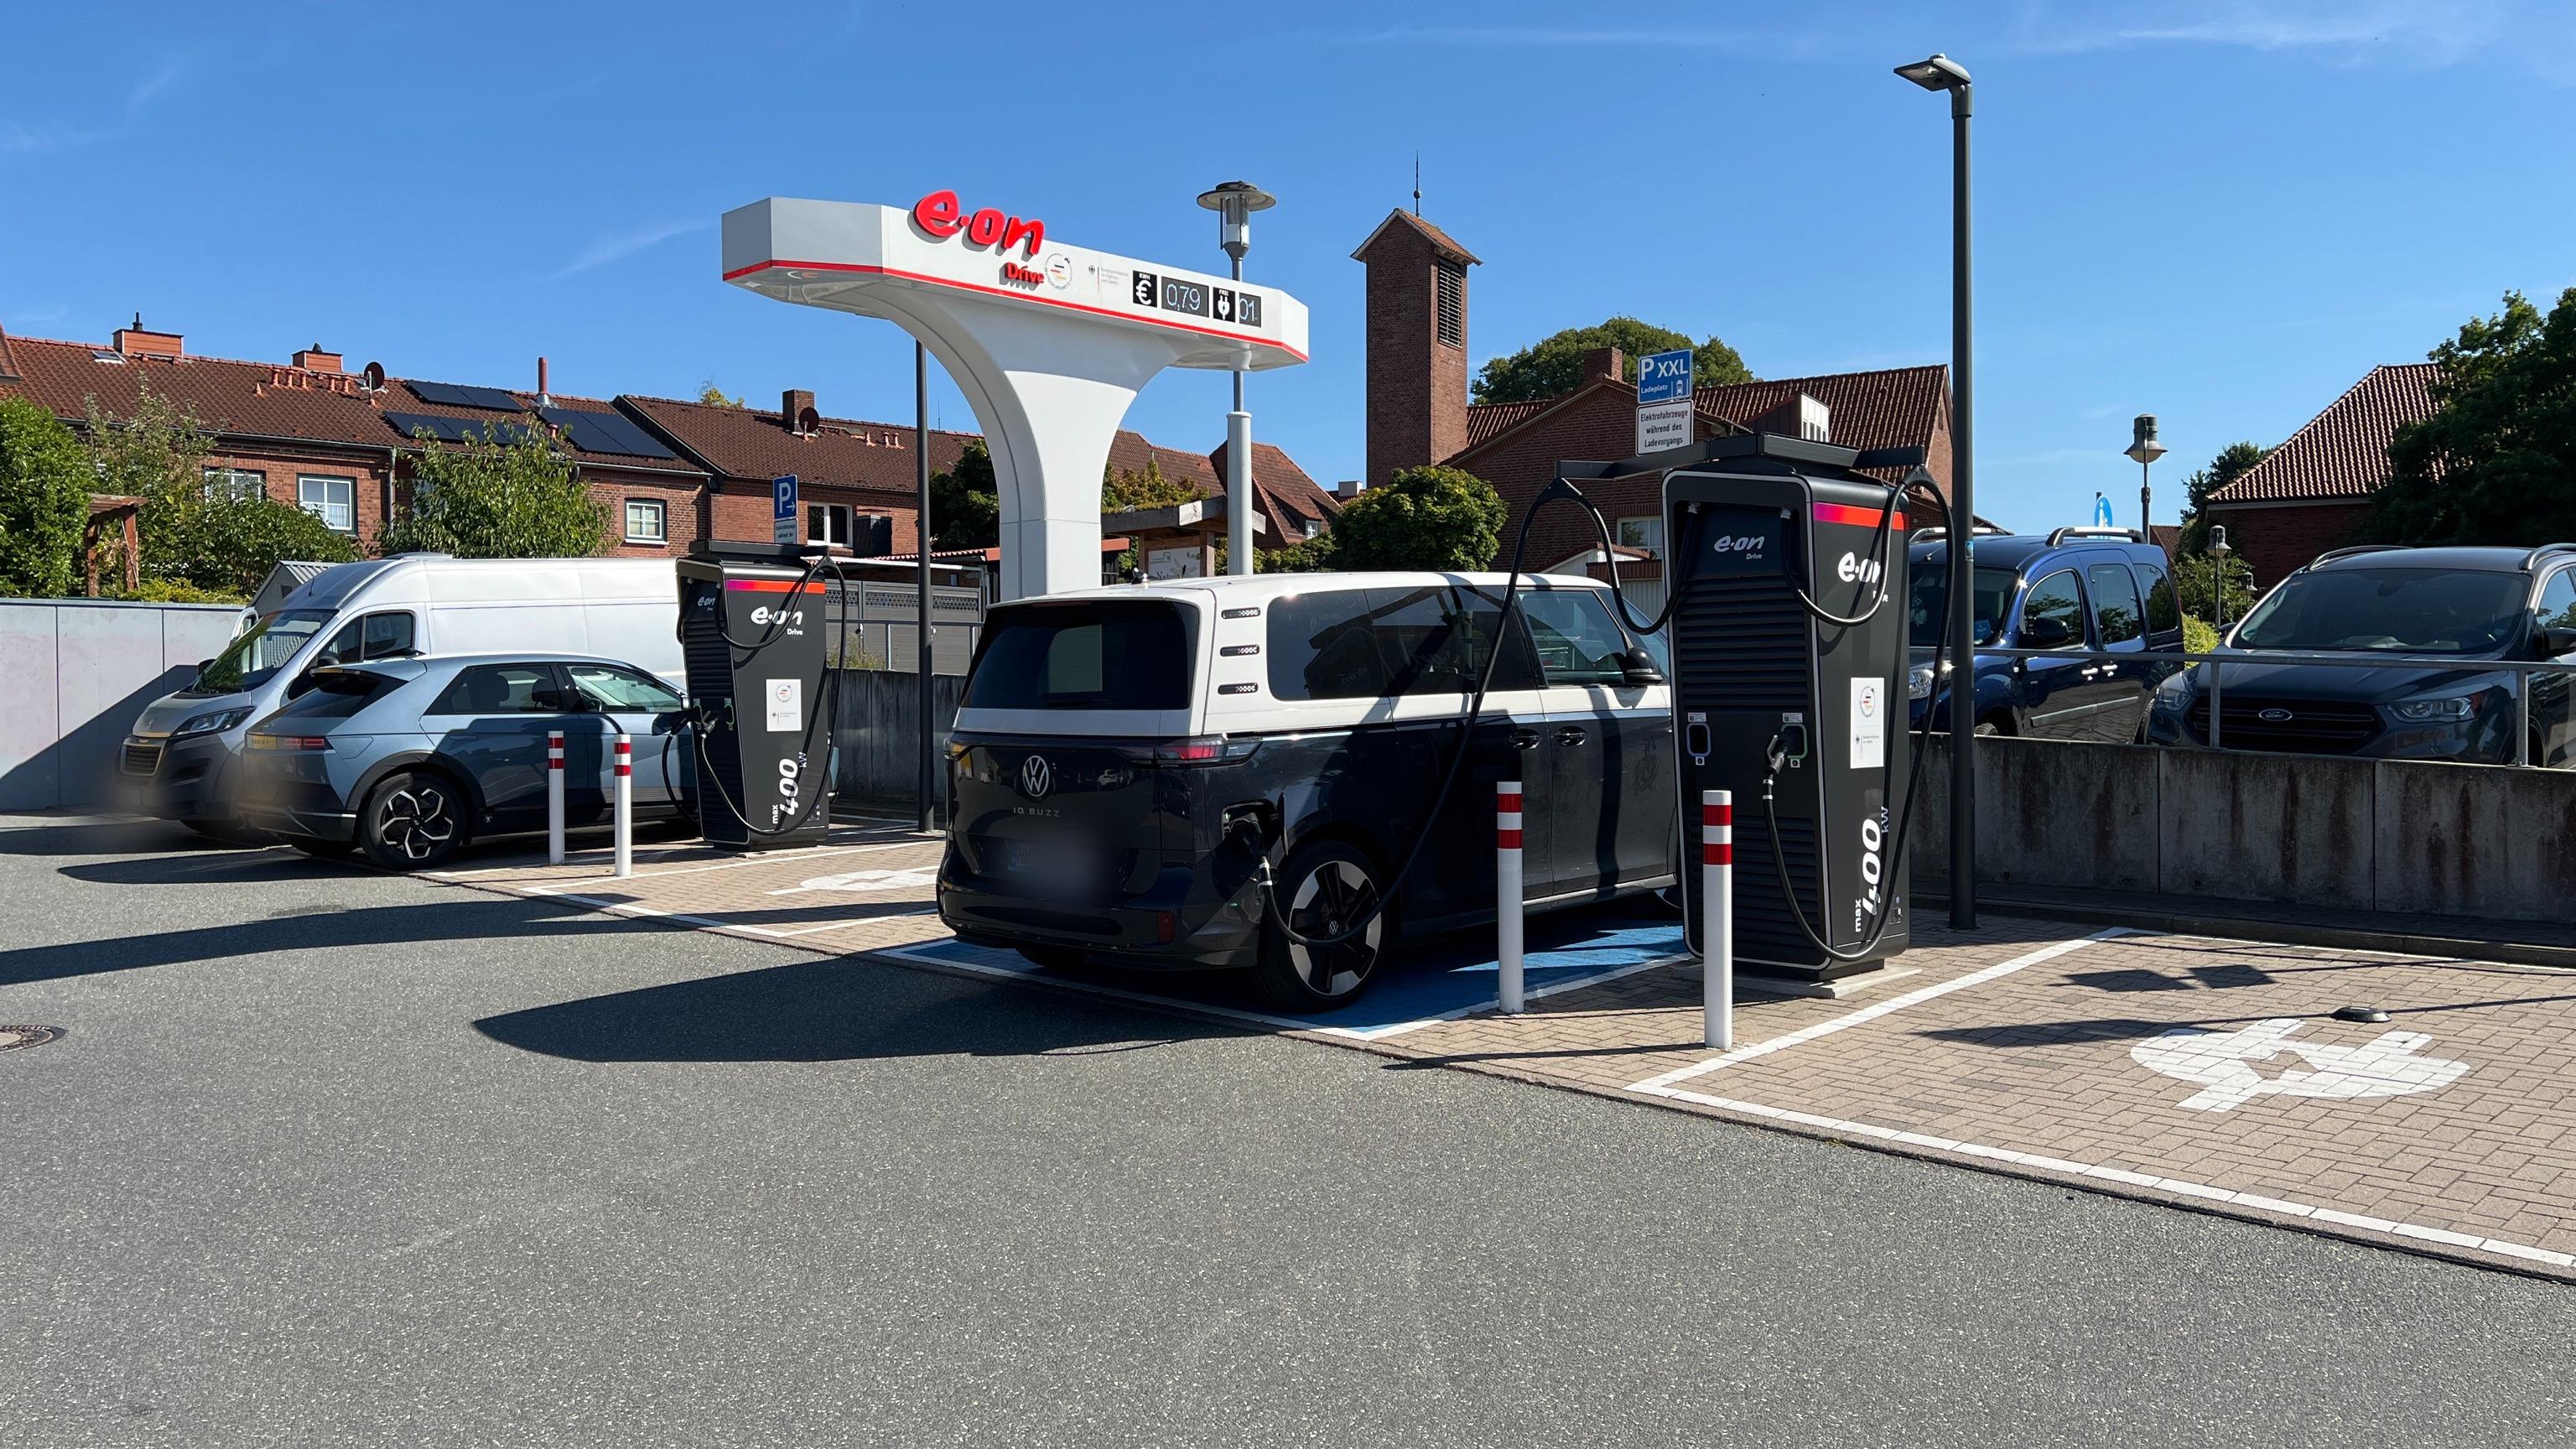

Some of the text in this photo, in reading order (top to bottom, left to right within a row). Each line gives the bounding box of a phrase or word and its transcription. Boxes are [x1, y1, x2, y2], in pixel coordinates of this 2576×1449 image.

[1005, 261, 1045, 284] Drive
[1136, 280, 1152, 305] €
[1166, 283, 1201, 311] 0,79
[1641, 357, 1688, 381] P XXL
[1640, 383, 1669, 394] Ladeplatz
[1640, 409, 1689, 423] Elektrofahrzeuge
[1646, 423, 1682, 434] während des
[1644, 436, 1683, 448] Ladevorgangs
[778, 482, 792, 514] P
[778, 751, 808, 816] 400 kW
[1029, 808, 1060, 818] BUZZ
[1862, 806, 1889, 916] 400 kW
